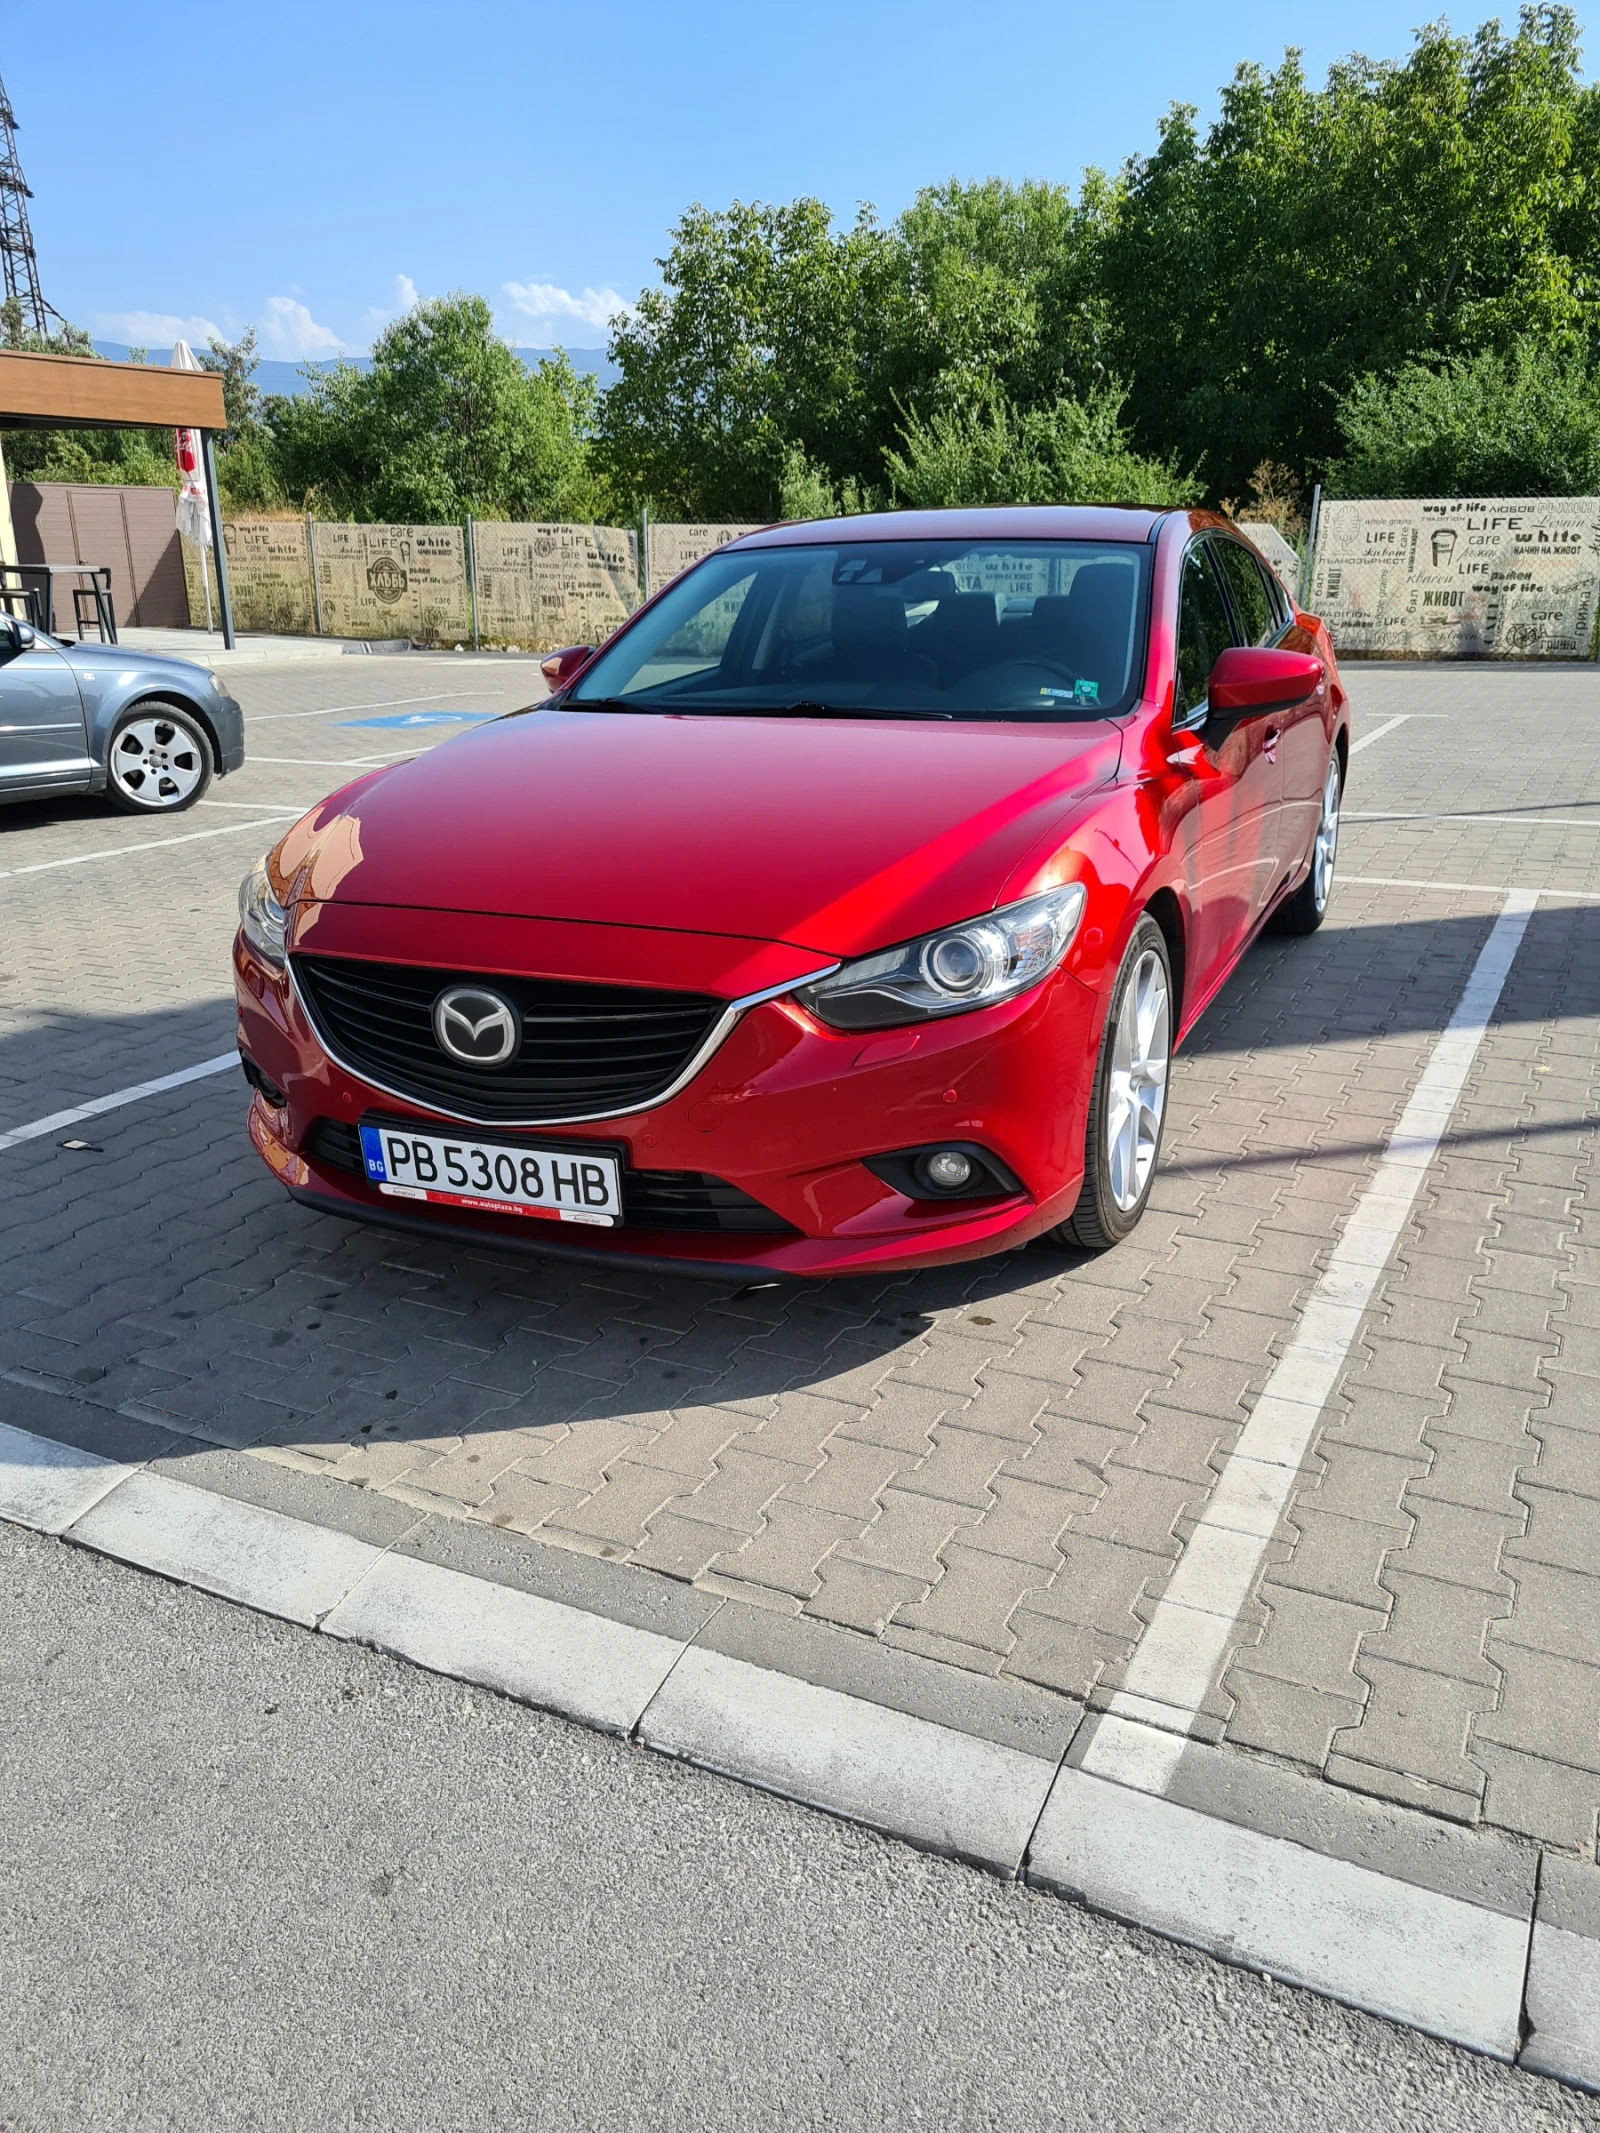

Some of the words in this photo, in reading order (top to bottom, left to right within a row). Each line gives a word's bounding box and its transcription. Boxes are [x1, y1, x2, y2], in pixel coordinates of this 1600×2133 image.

[1423, 504, 1447, 516] way
[1450, 503, 1463, 512] of
[1466, 502, 1487, 512] life
[1489, 505, 1535, 514] ЛЮБОВ
[1466, 517, 1524, 530] LIFE
[390, 527, 414, 538] care
[537, 527, 551, 536] way
[553, 526, 560, 534] of
[689, 528, 708, 537] care
[1515, 530, 1582, 543] white
[244, 535, 270, 545] LIFE
[333, 534, 349, 543] LIFE
[416, 537, 451, 547] white
[562, 536, 593, 547] LIFE
[1366, 532, 1396, 543] LIFE
[1400, 526, 1410, 548] care
[1468, 535, 1501, 545] care
[268, 545, 297, 553] white
[369, 538, 398, 549] LIFE
[502, 547, 519, 557] LIFE
[560, 551, 580, 560] care
[680, 550, 699, 560] LIFE
[1514, 546, 1540, 555] НАЧИН
[1541, 546, 1552, 555] НА
[1553, 546, 1582, 555] ЖИВОТ
[587, 551, 625, 563] white
[985, 561, 1033, 571] white
[1458, 563, 1489, 575] LIFE
[558, 581, 577, 591] LIFE
[1010, 582, 1033, 594] LIFE
[1326, 567, 1342, 599] ЖИВОТ
[1472, 584, 1499, 595] way
[1502, 584, 1517, 592] of
[1520, 584, 1543, 592] life
[361, 598, 377, 607] LIFE
[434, 597, 452, 605] care
[1422, 590, 1465, 607] ЖИВОТ
[1531, 611, 1564, 621] care
[1575, 591, 1591, 637] грижа
[1384, 617, 1407, 626] LIFE
[1540, 640, 1577, 651] грижа
[368, 1159, 384, 1172] BG
[443, 1145, 544, 1198] 5308
[461, 1198, 523, 1213] www.autoplaza.bg
